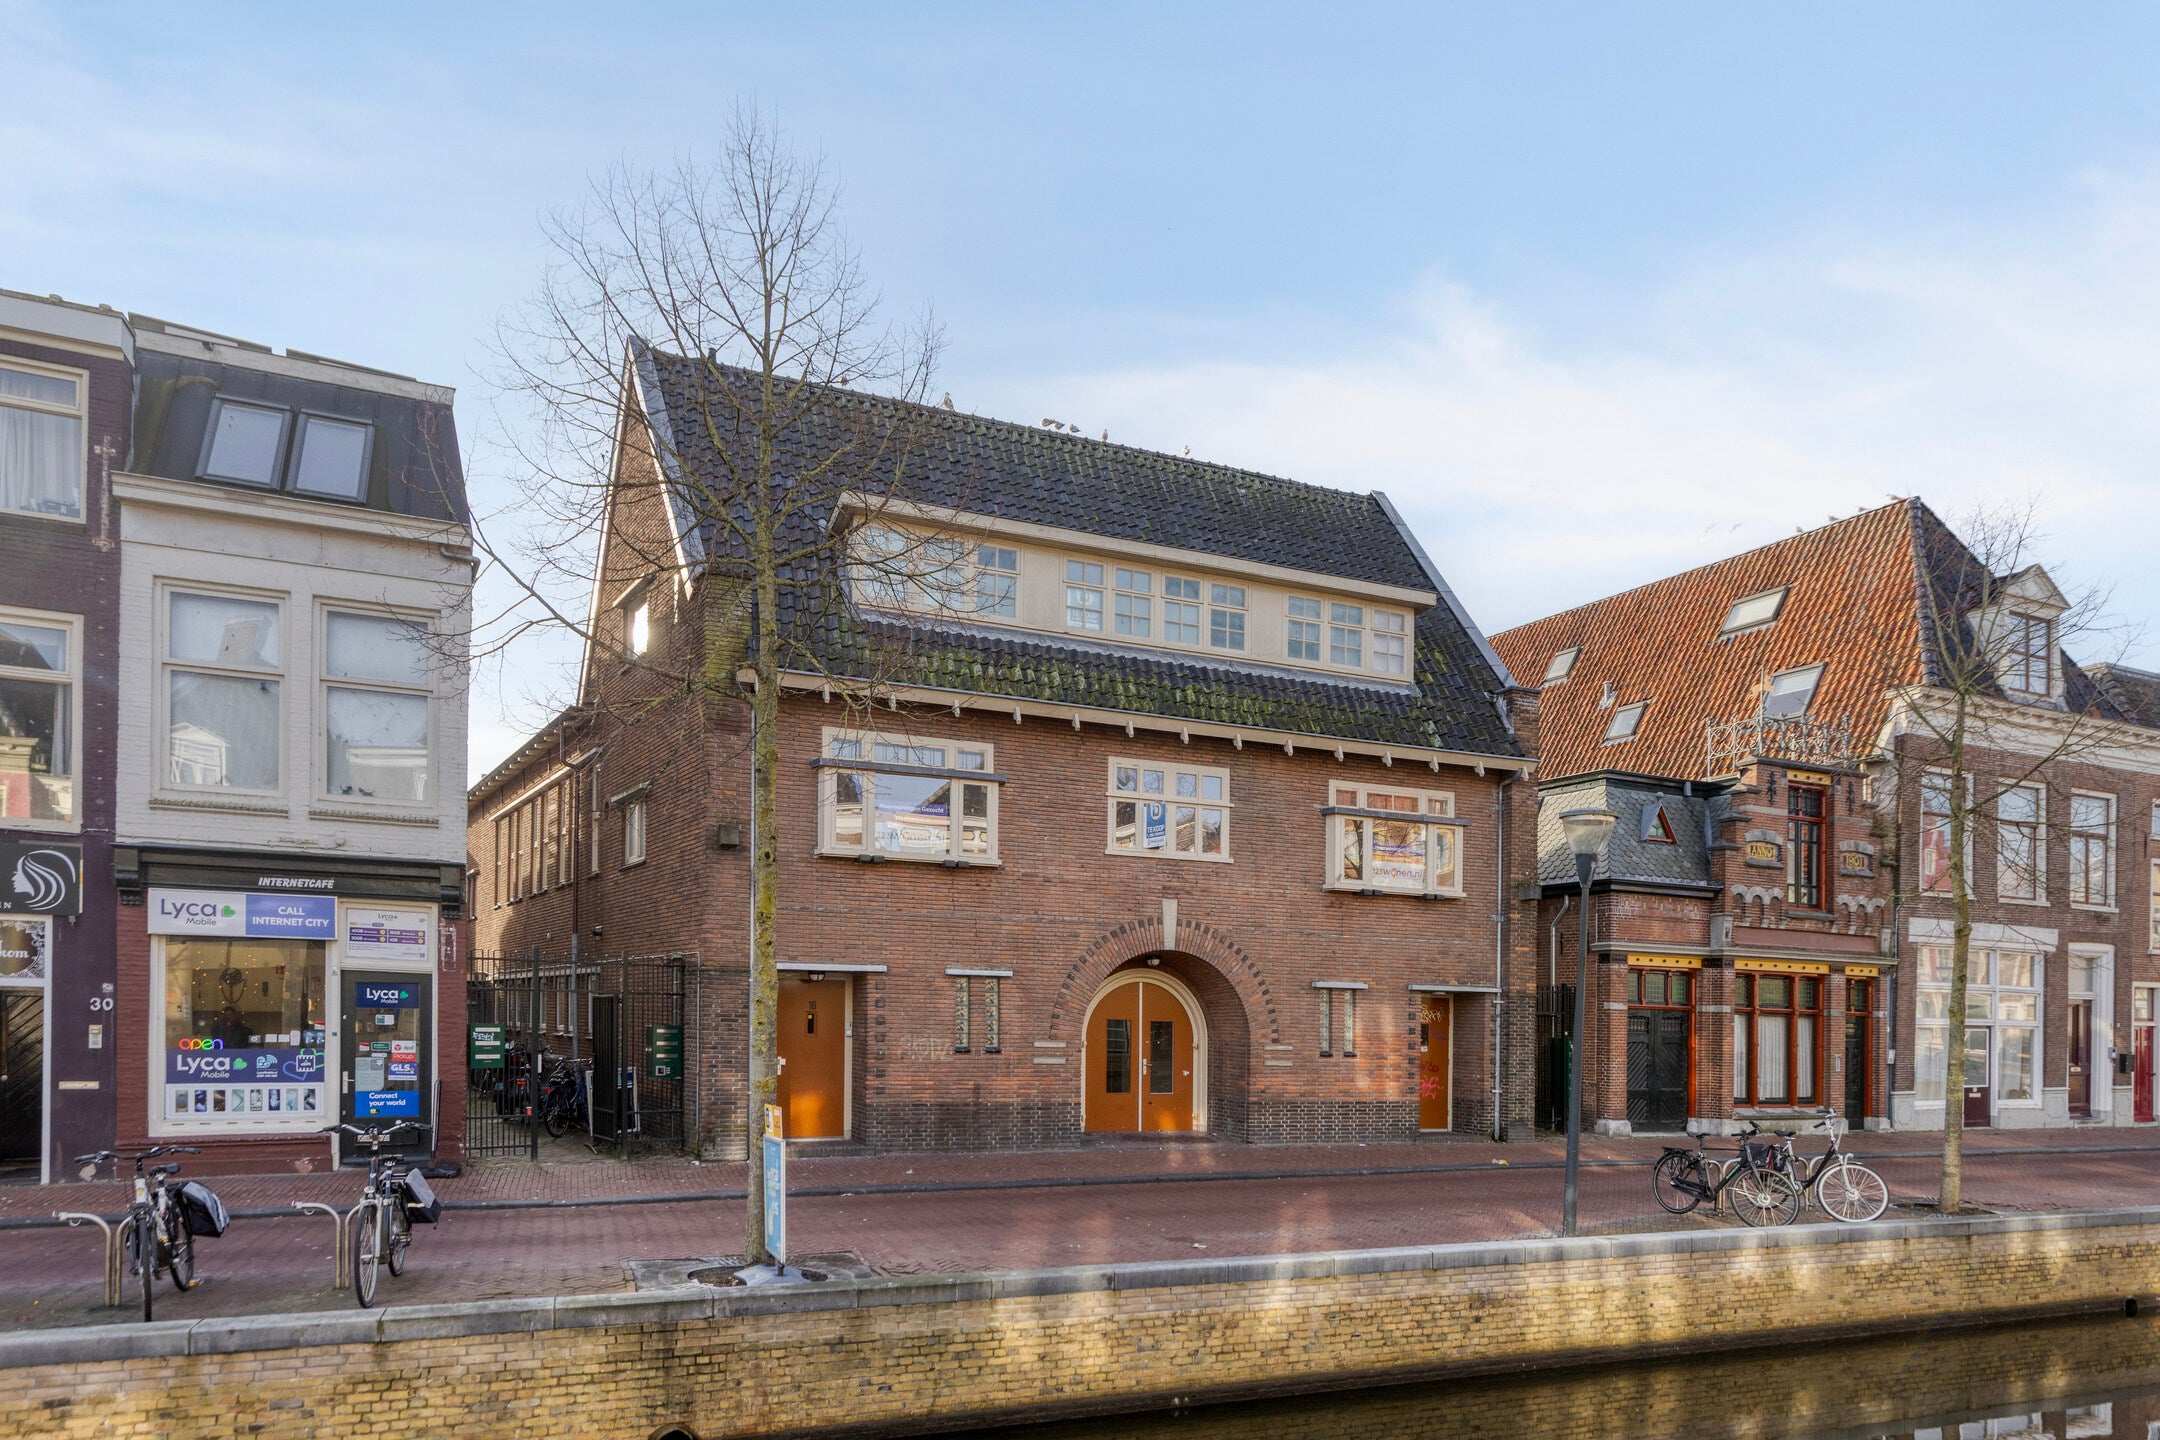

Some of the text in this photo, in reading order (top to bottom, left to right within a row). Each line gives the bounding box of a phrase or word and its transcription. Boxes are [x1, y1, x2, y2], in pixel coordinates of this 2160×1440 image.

[1750, 844, 1774, 858] ANNO
[258, 877, 335, 889] INTERNETCAFÉ
[160, 898, 217, 919] Lyca
[277, 906, 305, 915] CALL
[185, 917, 217, 926] Mobile
[252, 916, 330, 928] INTERNET CITY
[366, 988, 399, 1001] Lyca
[90, 997, 114, 1011] 30
[176, 1055, 230, 1074] Lyca
[391, 1063, 411, 1072] GLS
[200, 1070, 230, 1079] Mobile
